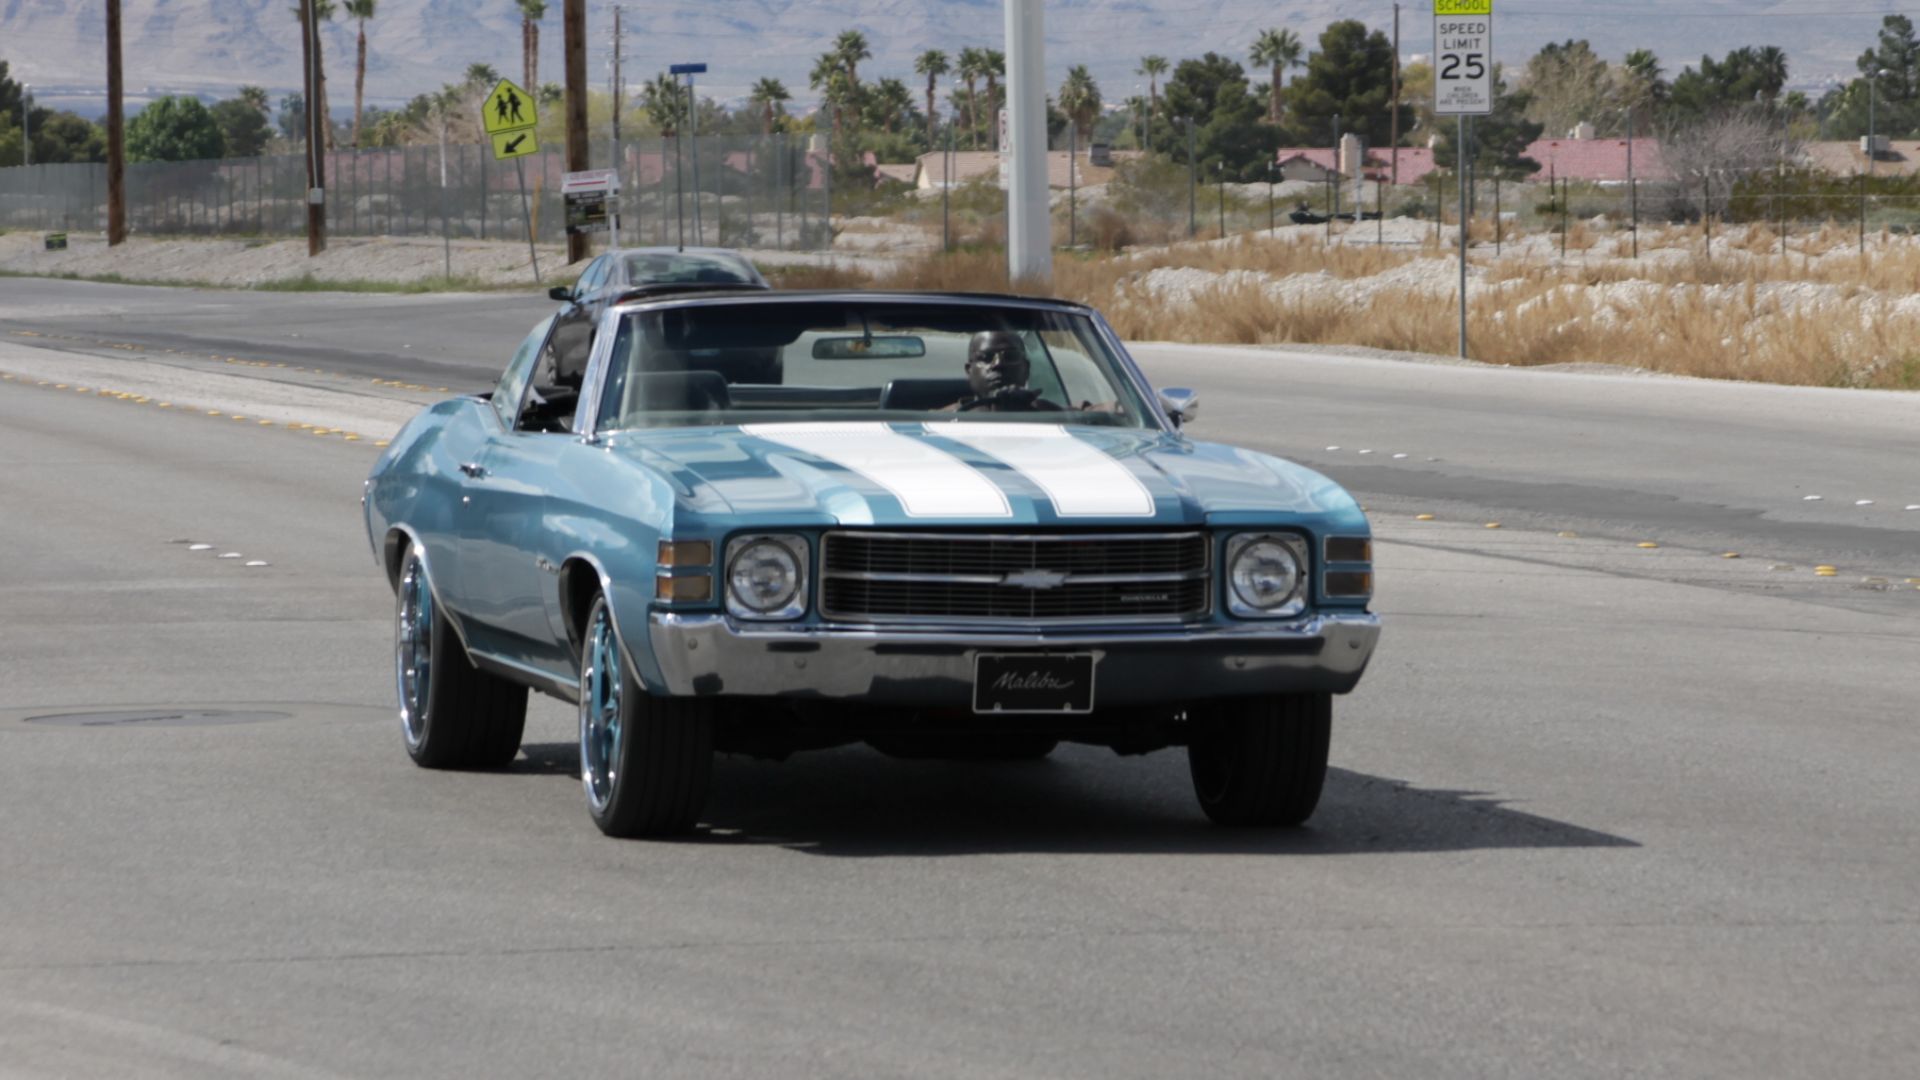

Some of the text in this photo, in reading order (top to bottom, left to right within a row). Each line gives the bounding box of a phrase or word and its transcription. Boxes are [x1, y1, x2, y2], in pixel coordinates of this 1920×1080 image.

[1438, 0, 1488, 10] SCHOOL
[1440, 23, 1486, 34] SPEED
[1443, 38, 1481, 49] LIMIT
[1441, 53, 1485, 79] 25
[992, 671, 1075, 689] Malibu
